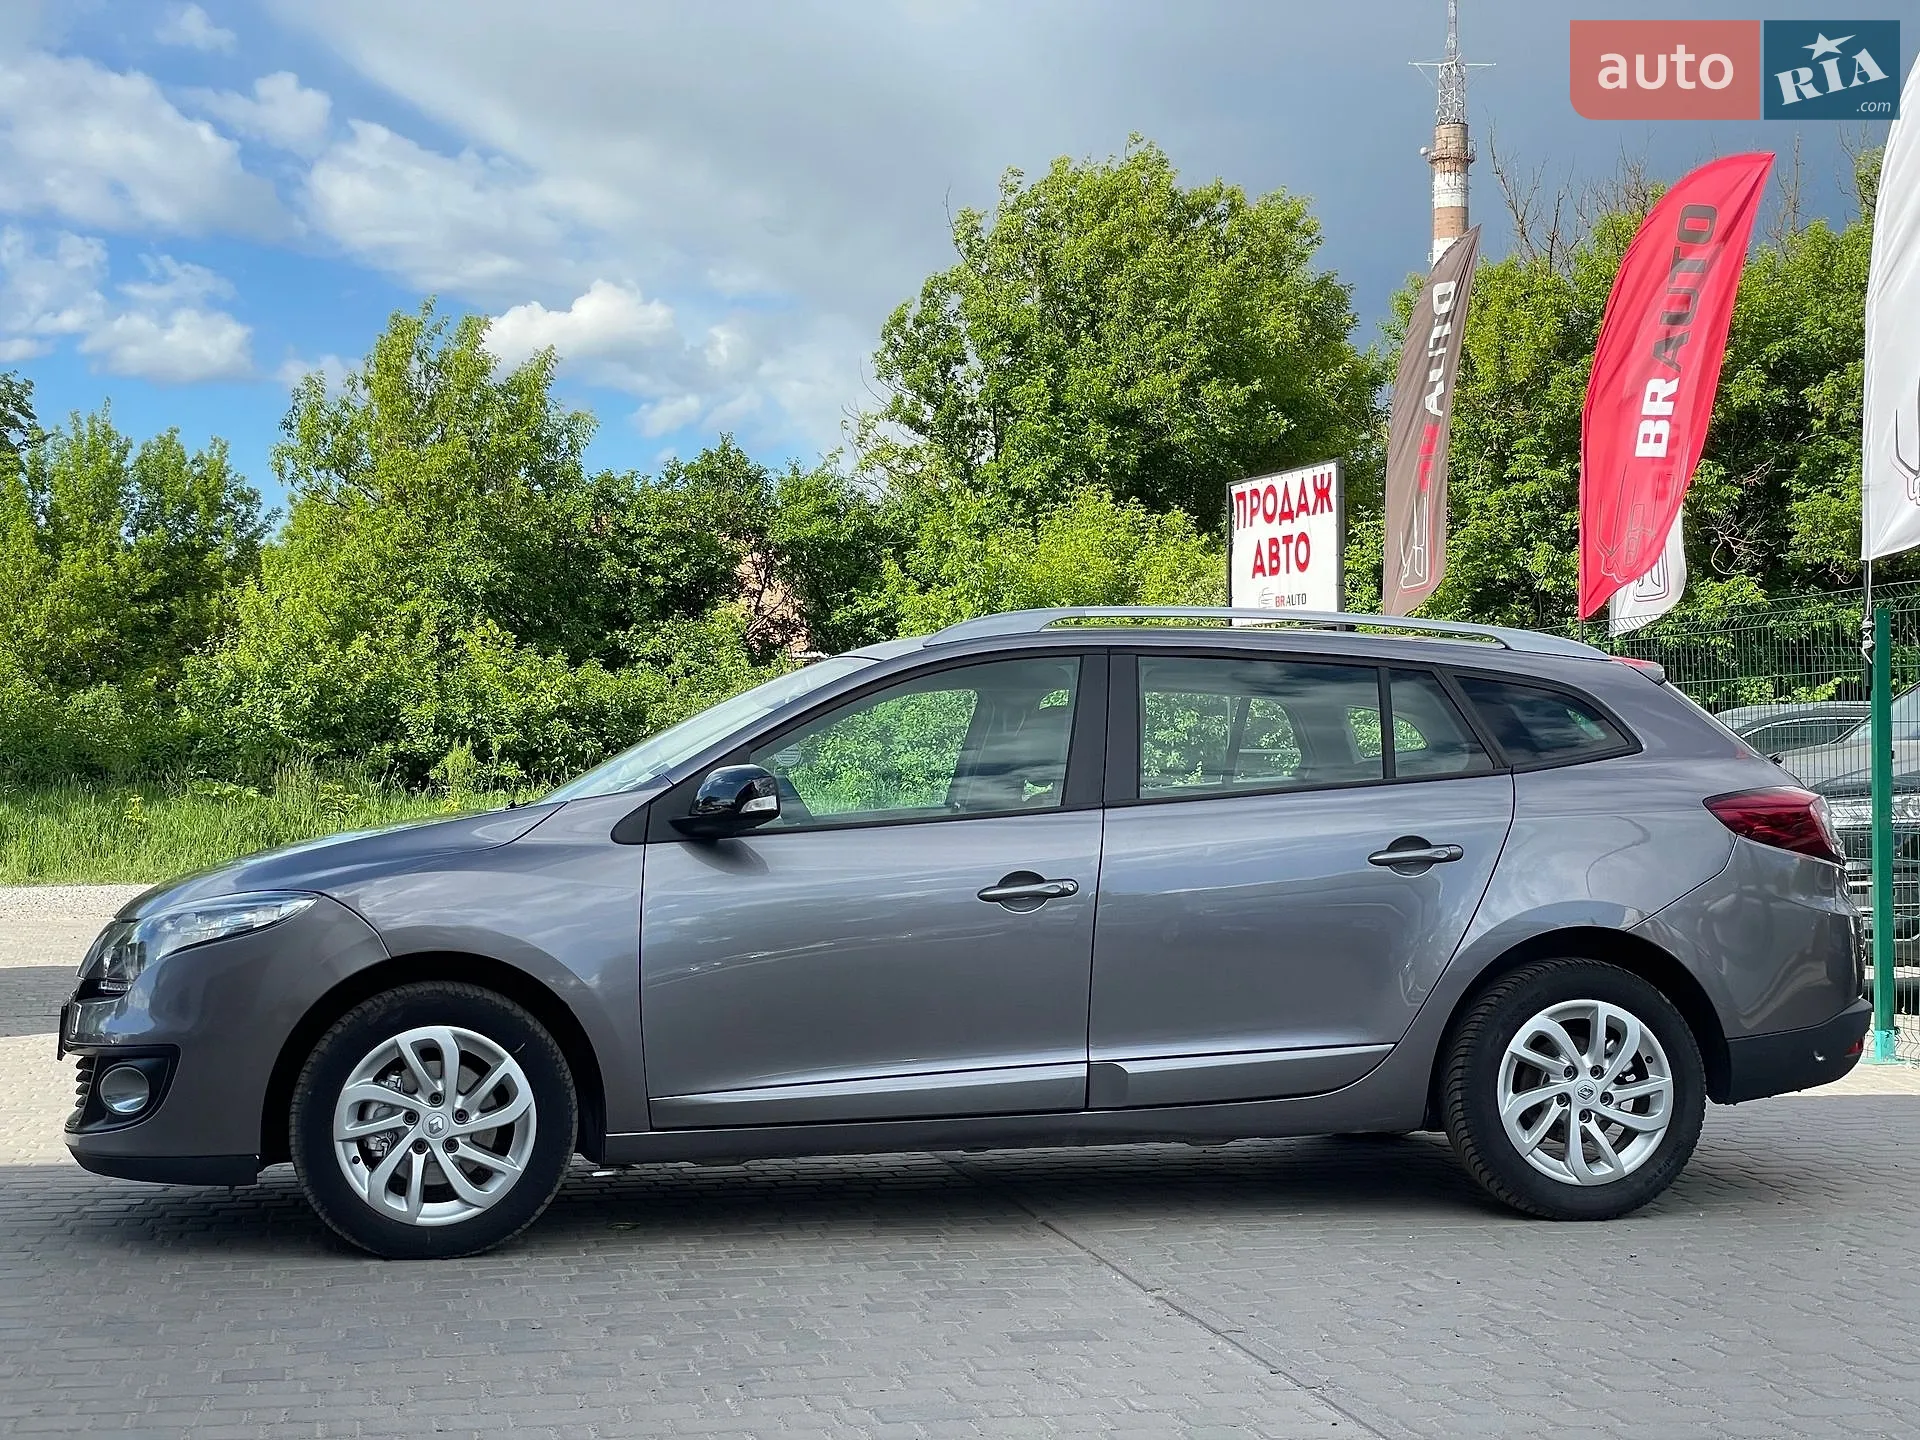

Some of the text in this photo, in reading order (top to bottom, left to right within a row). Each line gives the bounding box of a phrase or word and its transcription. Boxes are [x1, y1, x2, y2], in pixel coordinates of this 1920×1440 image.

[1634, 203, 1719, 459] BRAUTO
[1235, 472, 1334, 531] ПРОДАЖ
[1252, 532, 1311, 579] АВТО
[1275, 592, 1307, 607] BRAUTO
